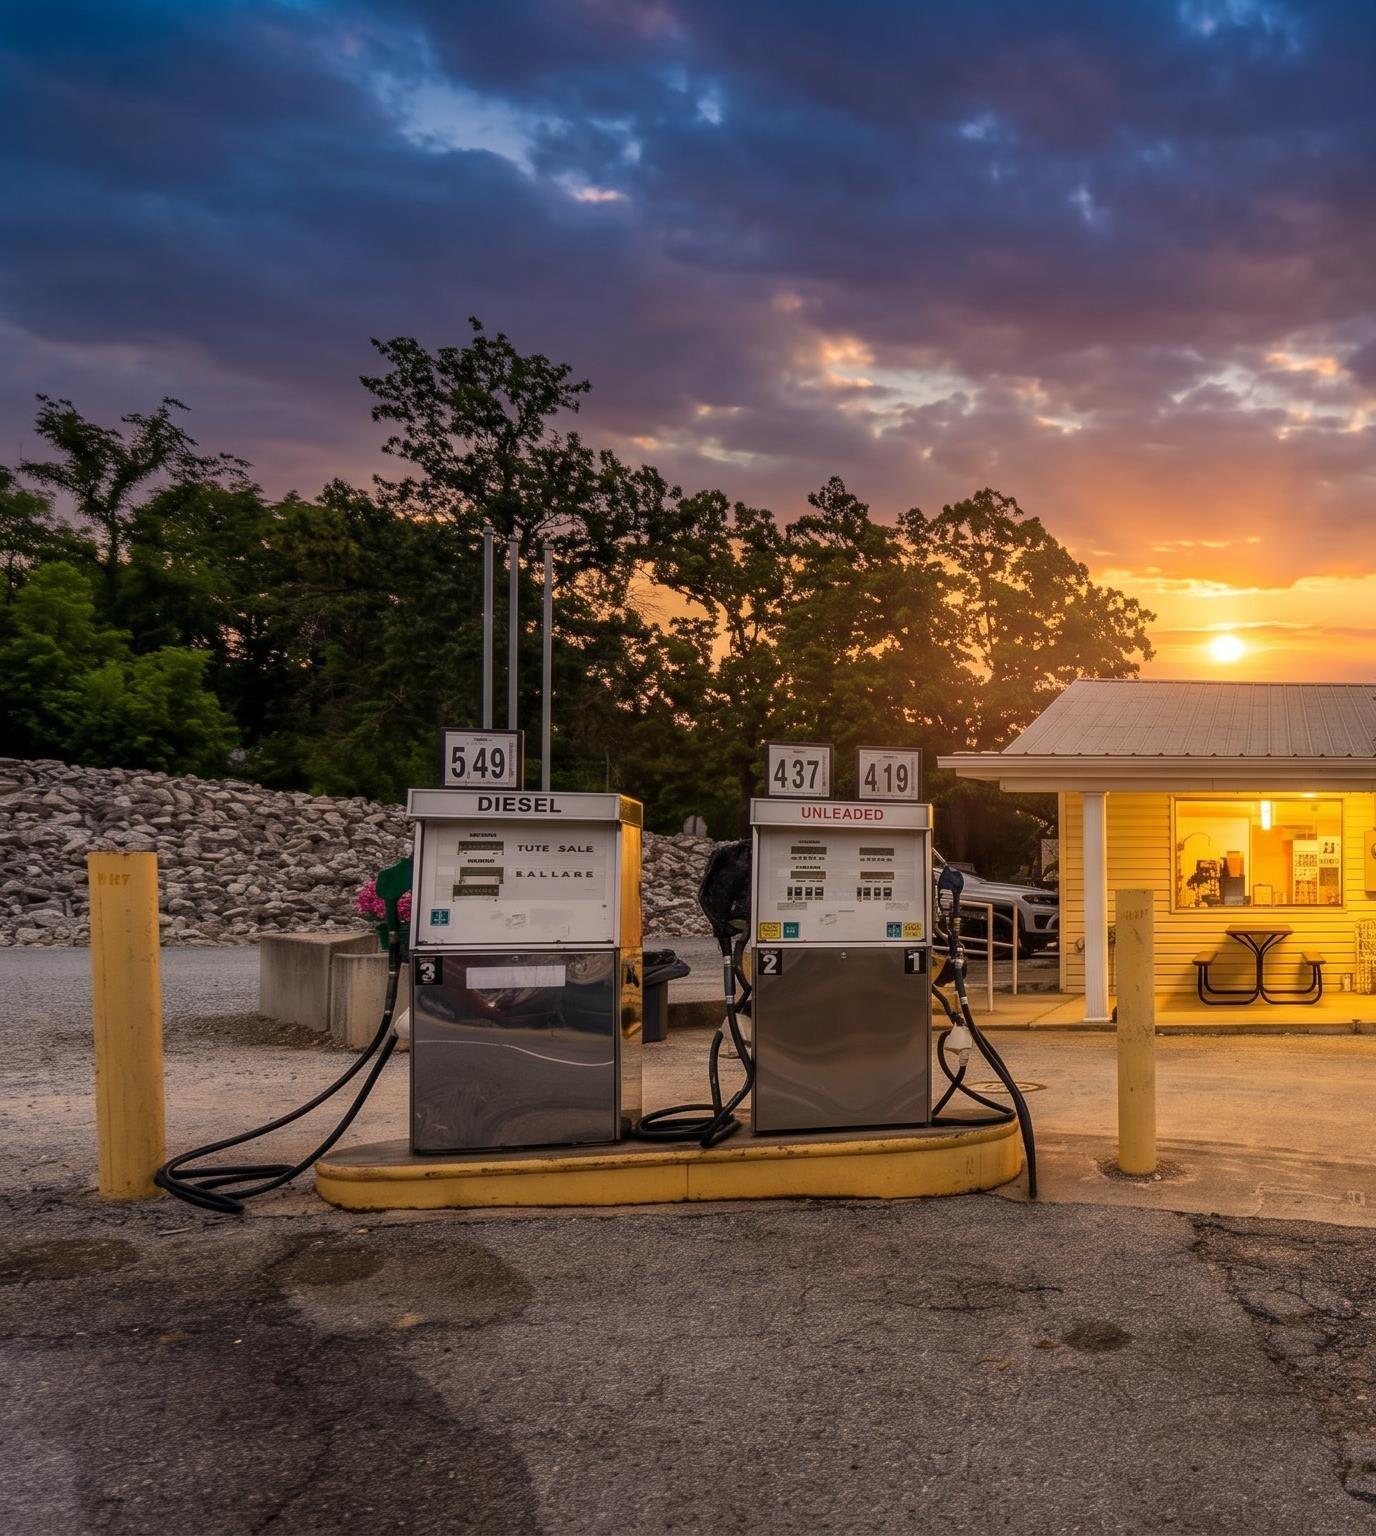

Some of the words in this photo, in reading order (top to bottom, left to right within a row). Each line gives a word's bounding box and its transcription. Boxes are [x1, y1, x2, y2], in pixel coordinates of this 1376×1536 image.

[774, 759, 819, 789] 437
[864, 763, 908, 792] 419
[478, 796, 562, 813] DIESEL
[801, 807, 884, 820] UNLEADED
[557, 845, 594, 853] SALE
[419, 962, 436, 982] 3
[762, 954, 777, 974] 2
[908, 952, 920, 972] 1
